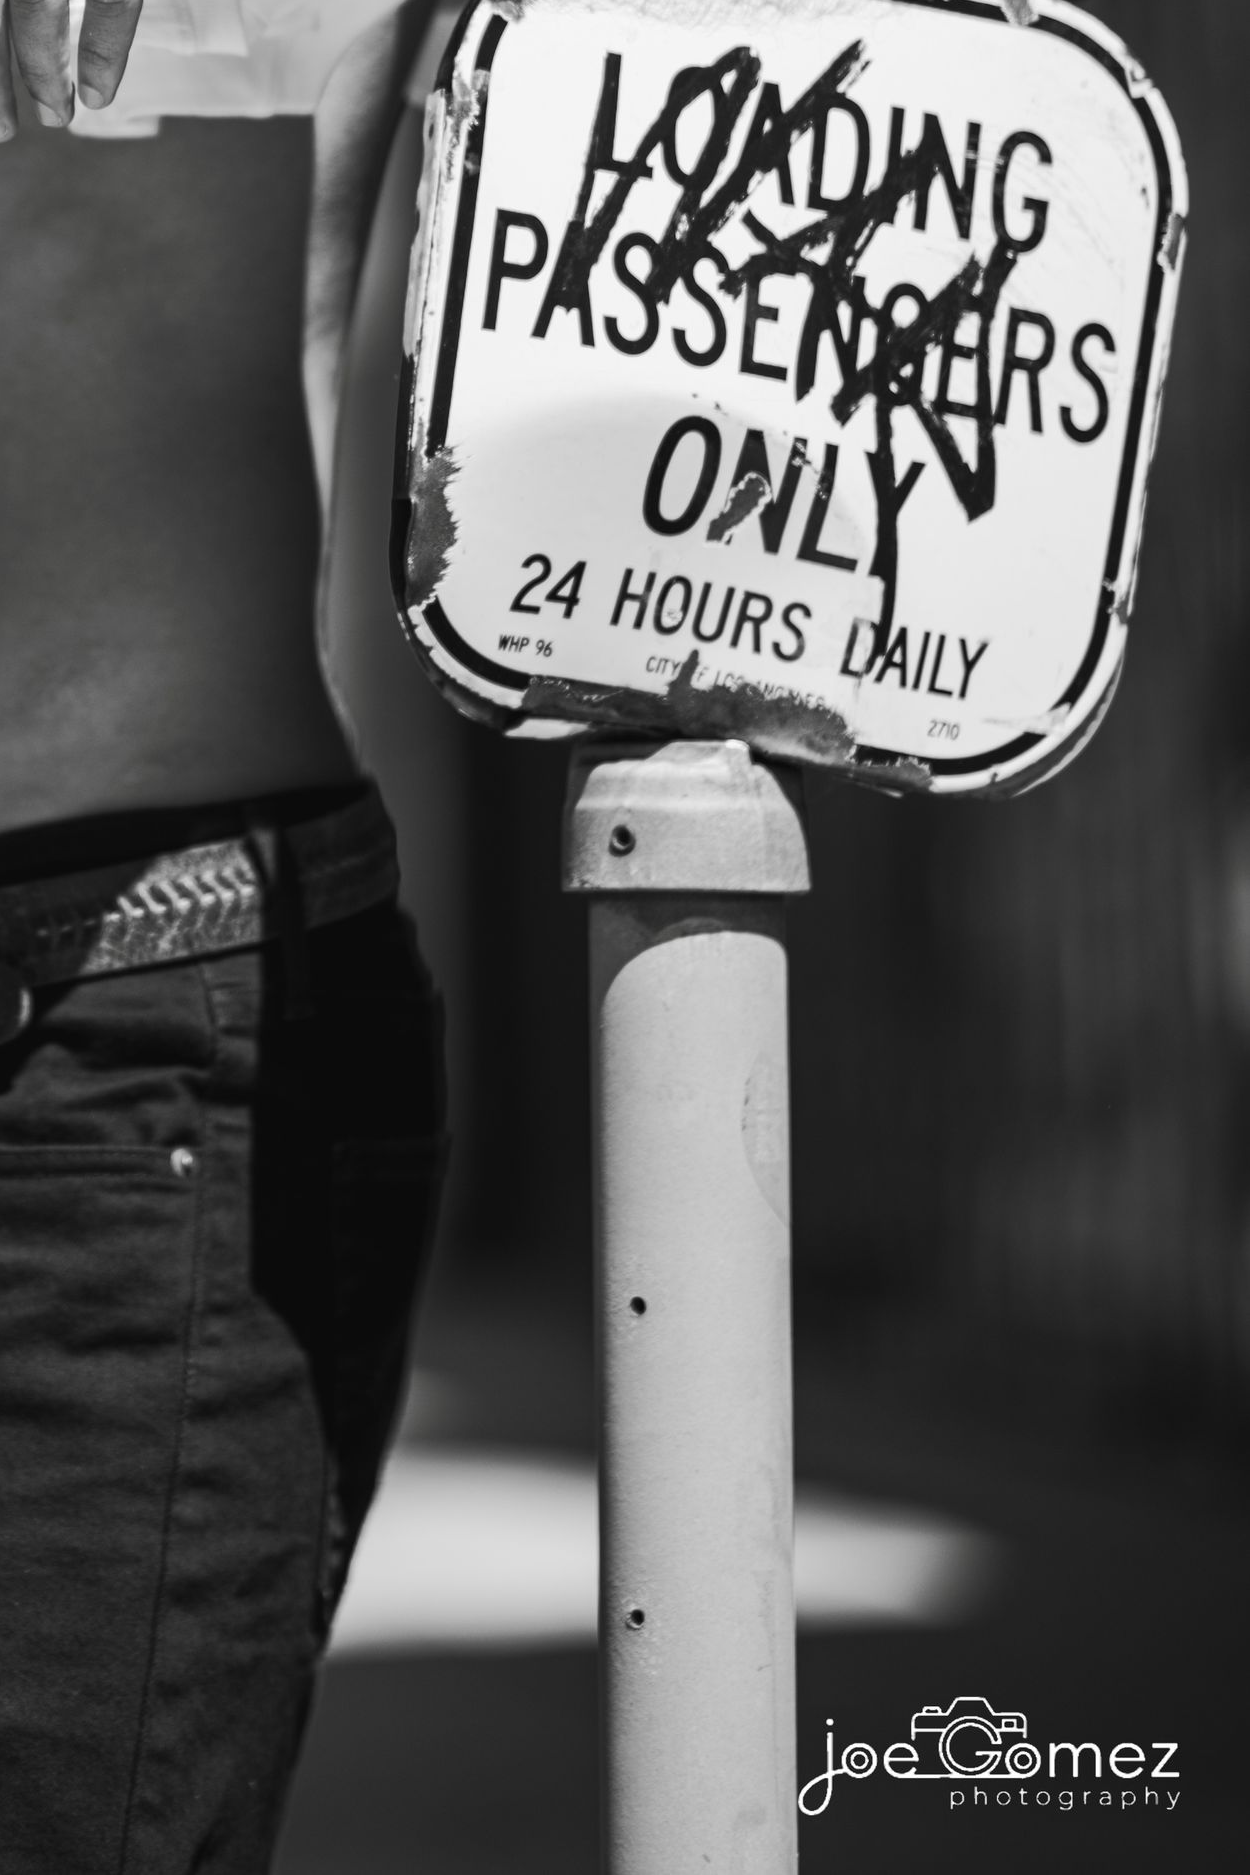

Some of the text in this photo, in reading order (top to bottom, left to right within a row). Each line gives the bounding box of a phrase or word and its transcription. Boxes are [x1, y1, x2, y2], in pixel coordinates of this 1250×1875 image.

[592, 51, 1054, 254] LOADING
[481, 208, 1118, 444] PASSENGERS
[642, 415, 926, 575] ONLY
[498, 634, 554, 658] WHP 96
[509, 553, 988, 700] 24 HOURS DAILY
[646, 656, 682, 676] CITY
[926, 720, 961, 741] 2710
